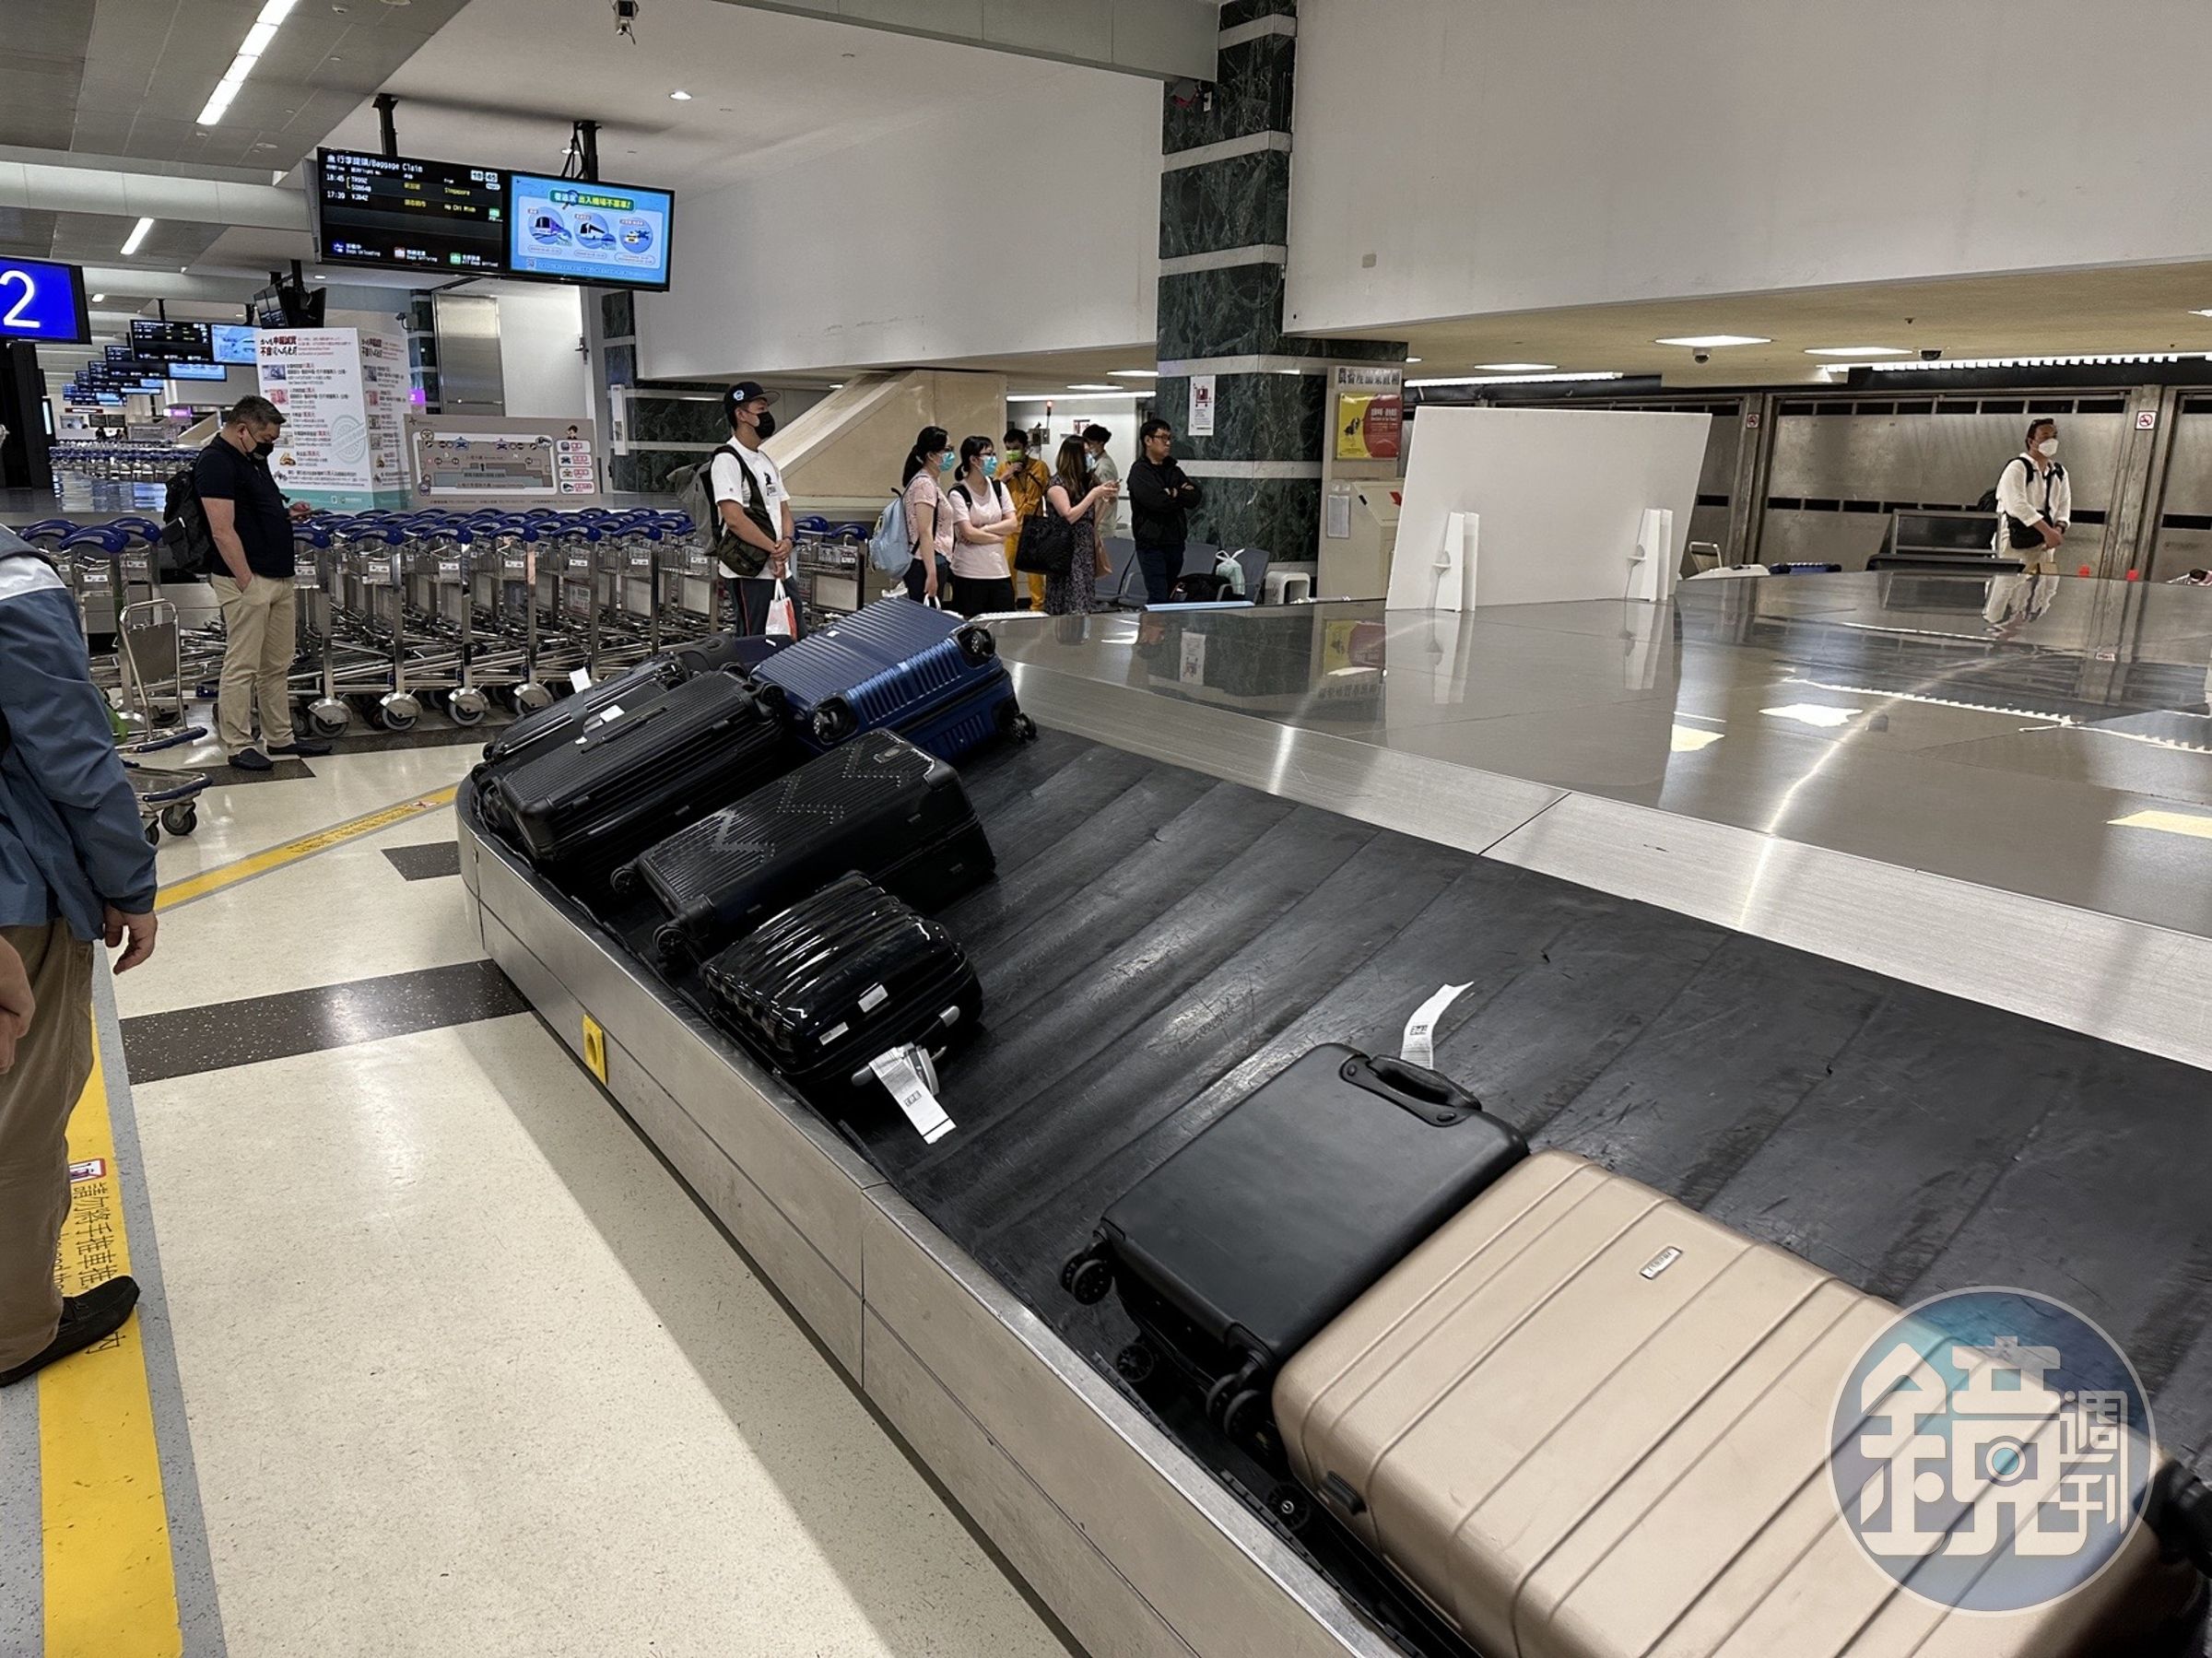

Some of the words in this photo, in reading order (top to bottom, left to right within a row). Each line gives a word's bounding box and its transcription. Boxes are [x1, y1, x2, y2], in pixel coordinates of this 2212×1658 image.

[402, 162, 423, 173] Claim
[444, 187, 471, 196] Singapore
[0, 269, 41, 329] 2
